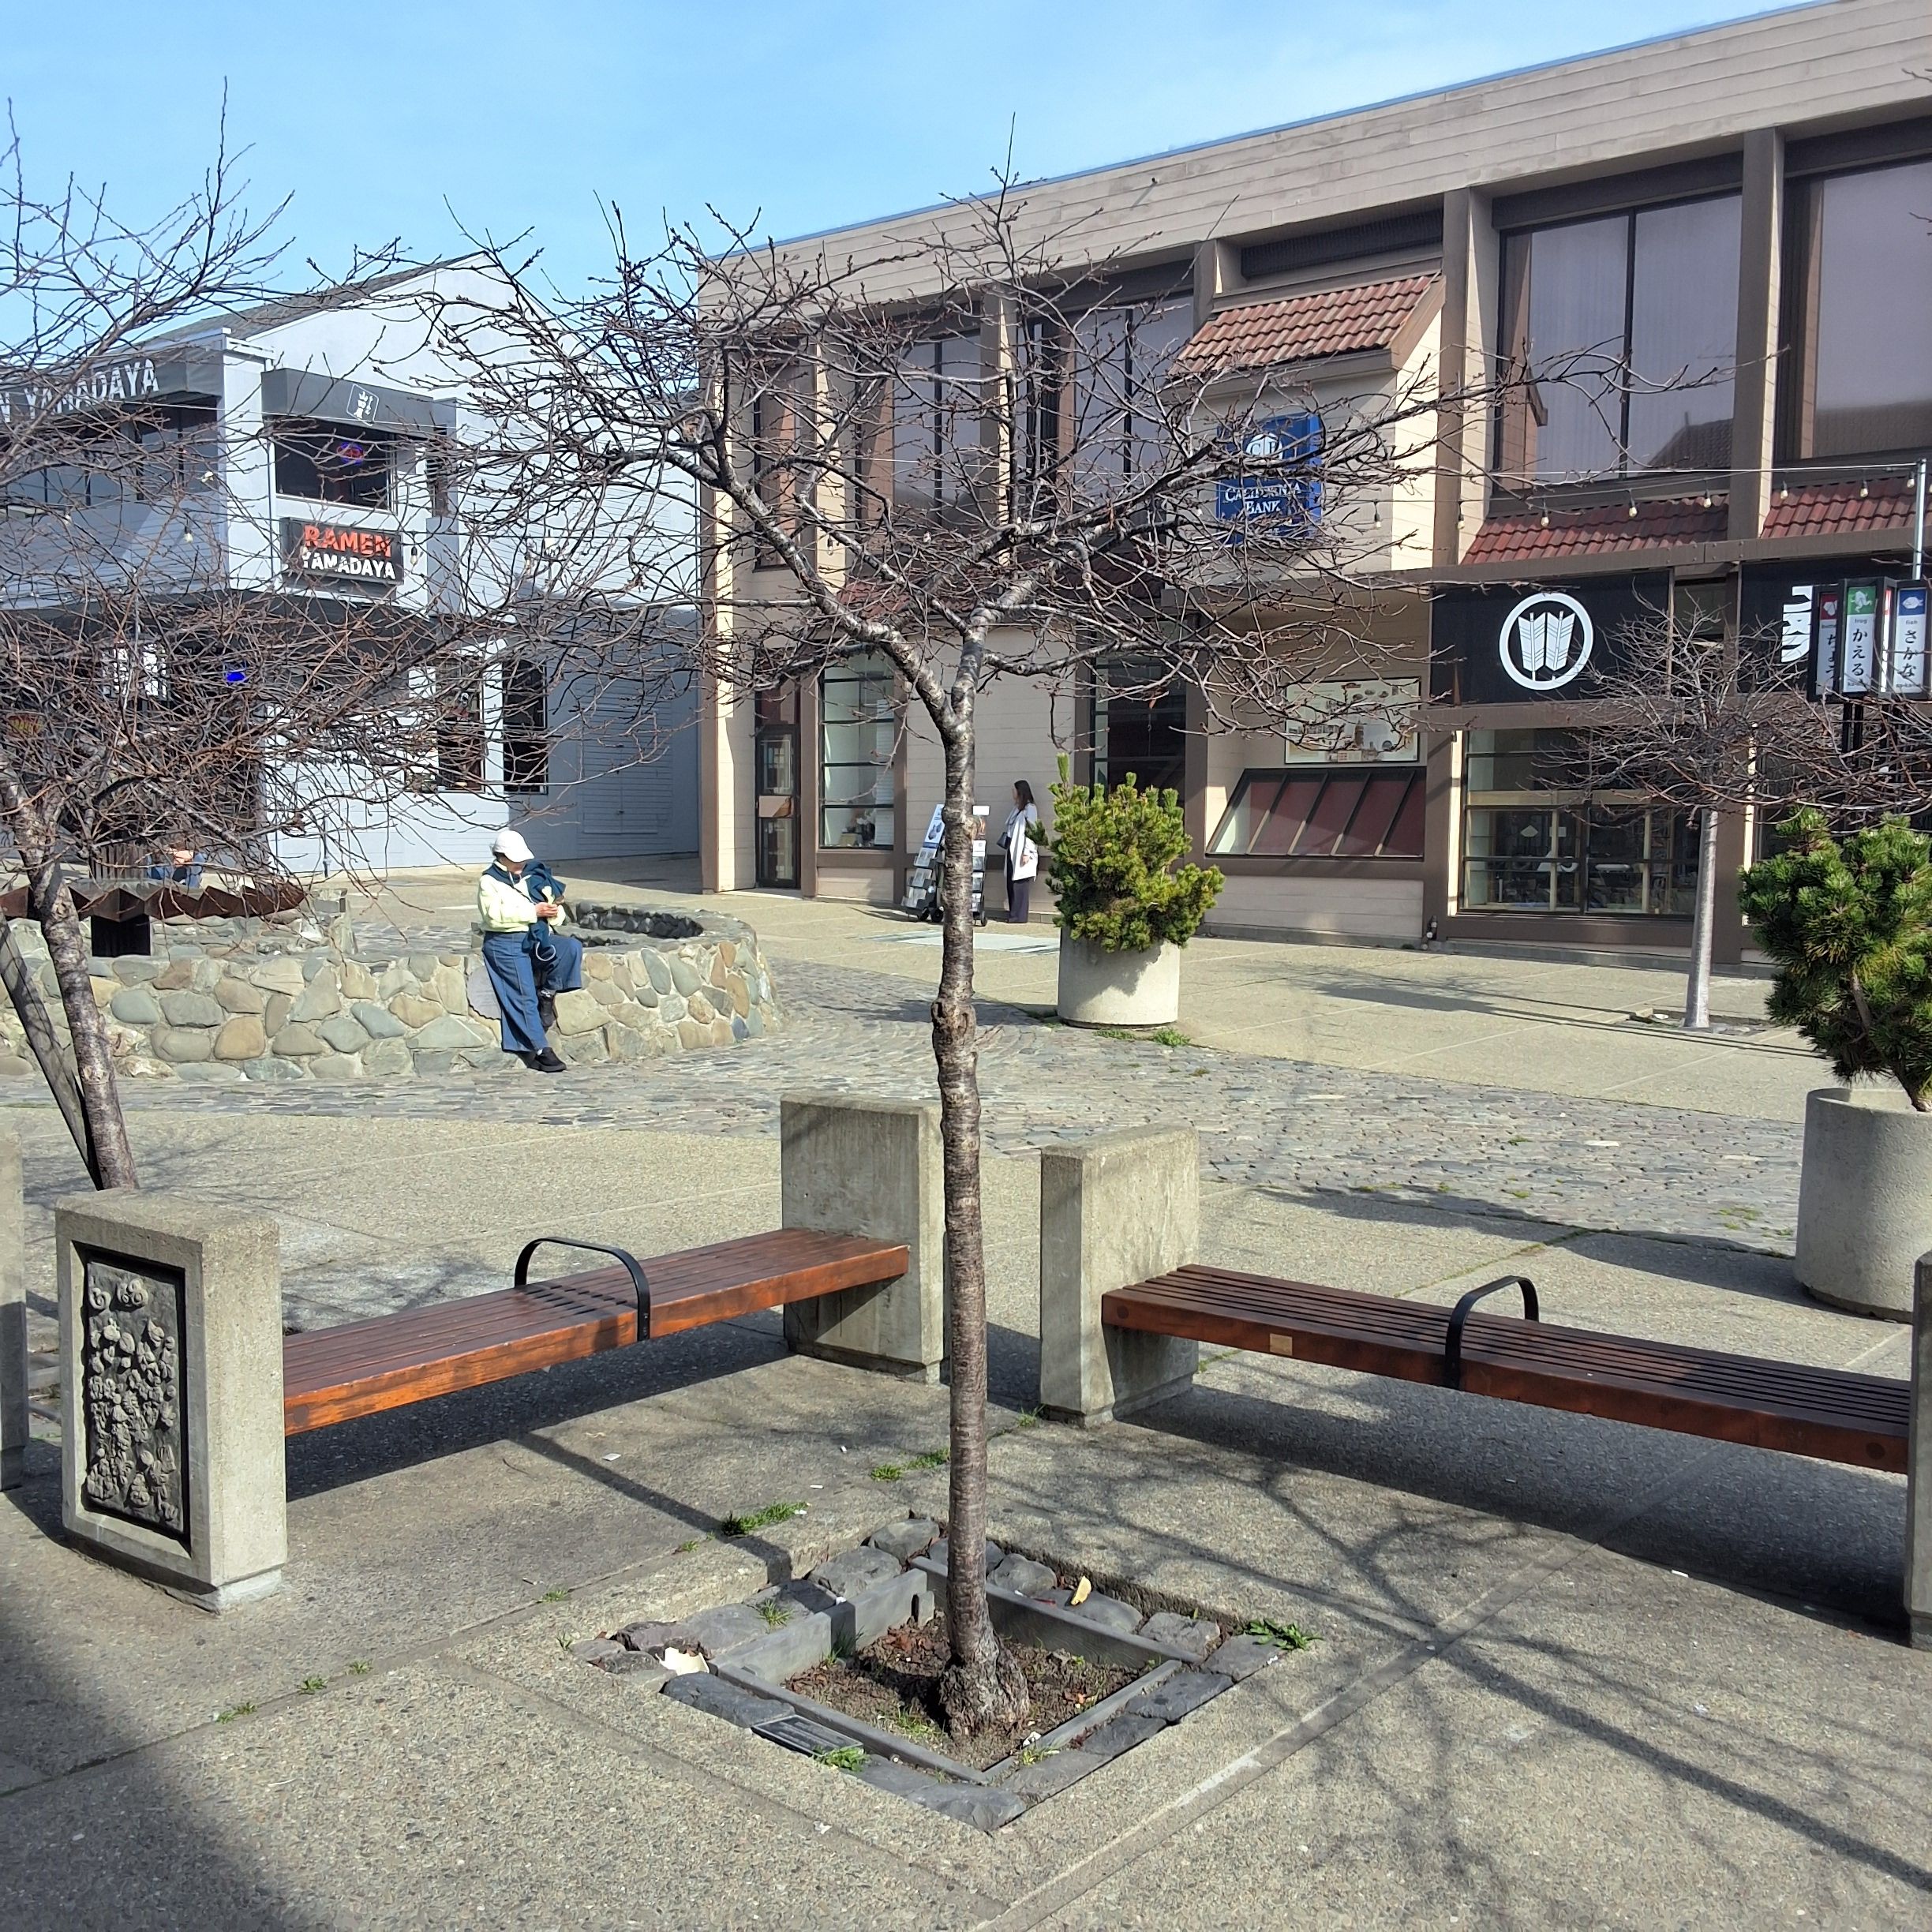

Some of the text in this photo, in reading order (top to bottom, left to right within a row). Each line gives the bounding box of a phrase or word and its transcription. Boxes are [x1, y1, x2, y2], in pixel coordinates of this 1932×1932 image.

[1226, 482, 1301, 501] CALIFNA
[303, 524, 392, 559] RAMEN
[301, 552, 396, 580] YAMADAYA
[1852, 628, 1868, 676] かえる
[1903, 630, 1917, 677] さかな
